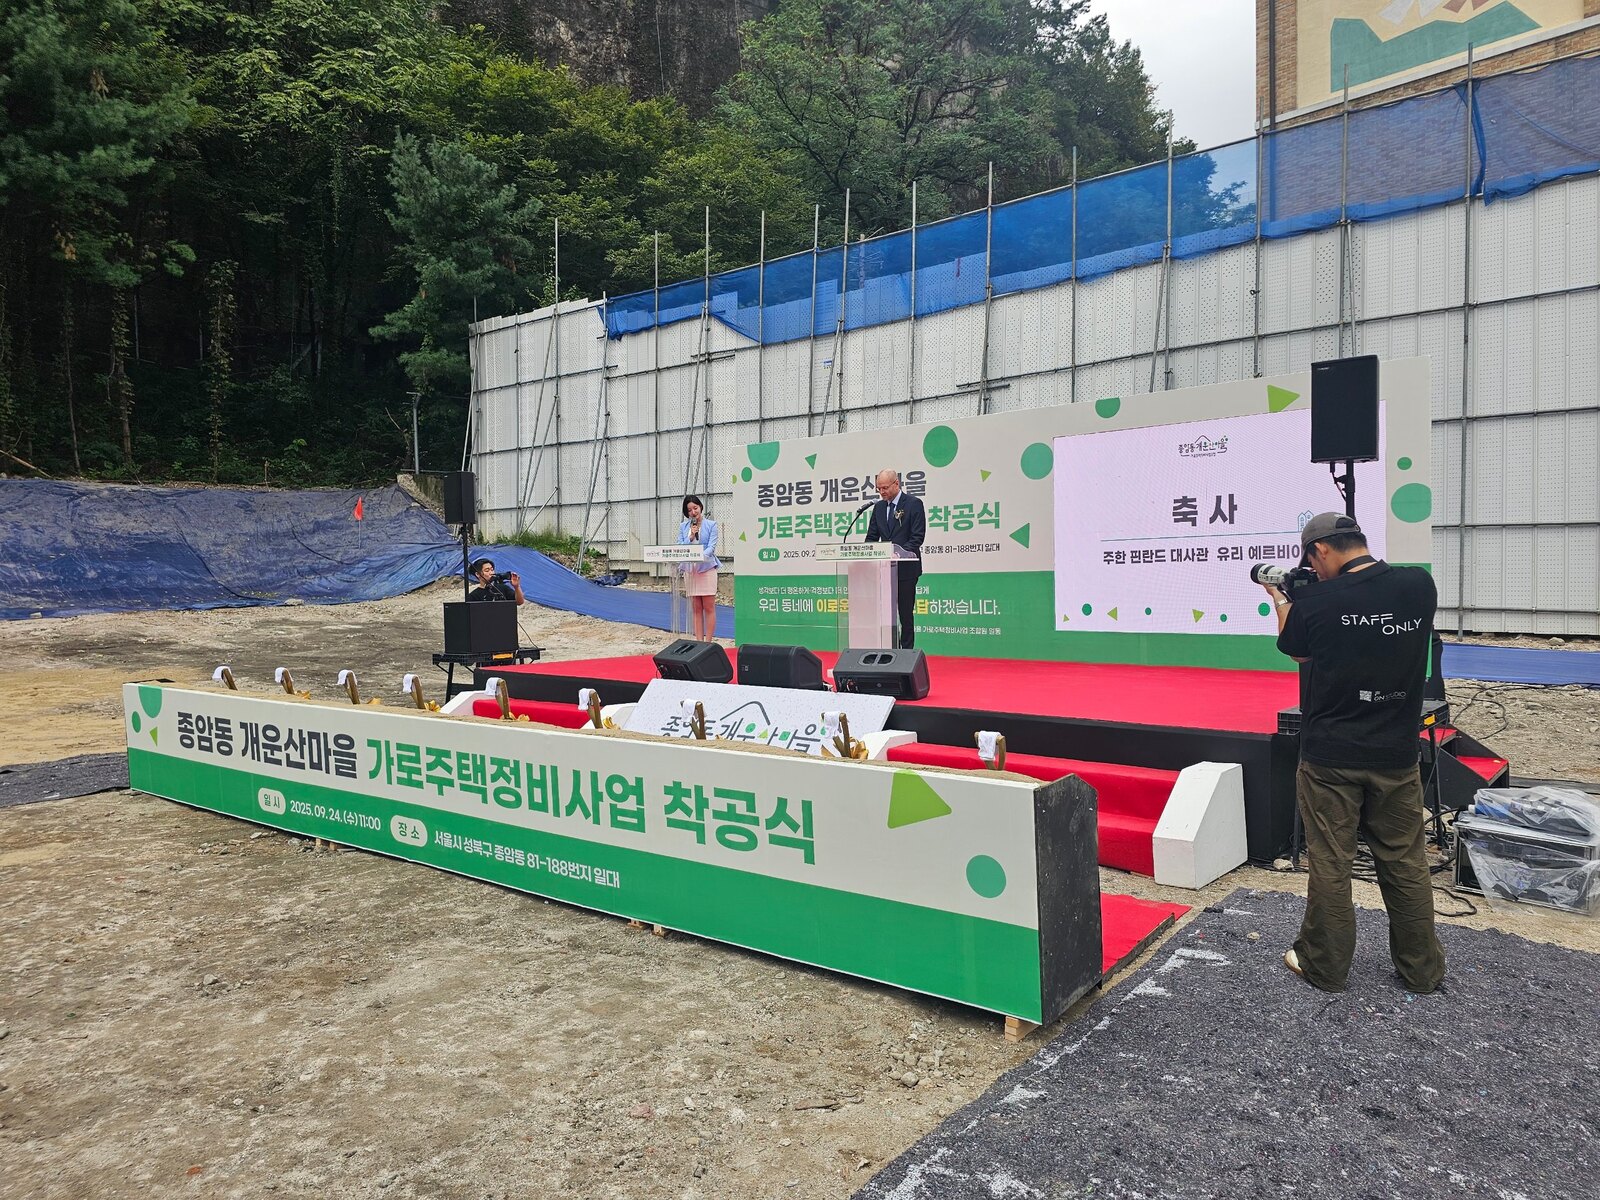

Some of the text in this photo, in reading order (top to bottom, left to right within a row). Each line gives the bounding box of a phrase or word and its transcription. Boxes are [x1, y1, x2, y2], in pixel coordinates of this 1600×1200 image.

[757, 470, 926, 508] 종암동 개운산을
[758, 501, 1000, 539] 가로주택정비 착공식
[783, 549, 816, 558] 2025.09.2
[924, 546, 943, 554] 종암동
[945, 543, 984, 553] 81-188번지
[984, 543, 1000, 552] 일대
[1103, 551, 1126, 565] 주한
[1130, 549, 1167, 564] 핀란드
[1170, 547, 1209, 563] 대사관
[1217, 546, 1243, 561] 유리
[915, 586, 929, 595] 답게
[759, 598, 779, 613] 우리
[781, 598, 814, 613] 동네에
[913, 599, 1001, 615] 답하겠습니다.
[1341, 613, 1422, 635] STAFF ONLY
[177, 711, 816, 866] 종암동 개운산마을 가로주택정비사업 착공식
[434, 830, 462, 850] 서울시
[463, 839, 493, 858] 성북구
[494, 844, 526, 867] 종암동
[527, 852, 592, 882] 81-188번지
[594, 867, 620, 888] 일대
